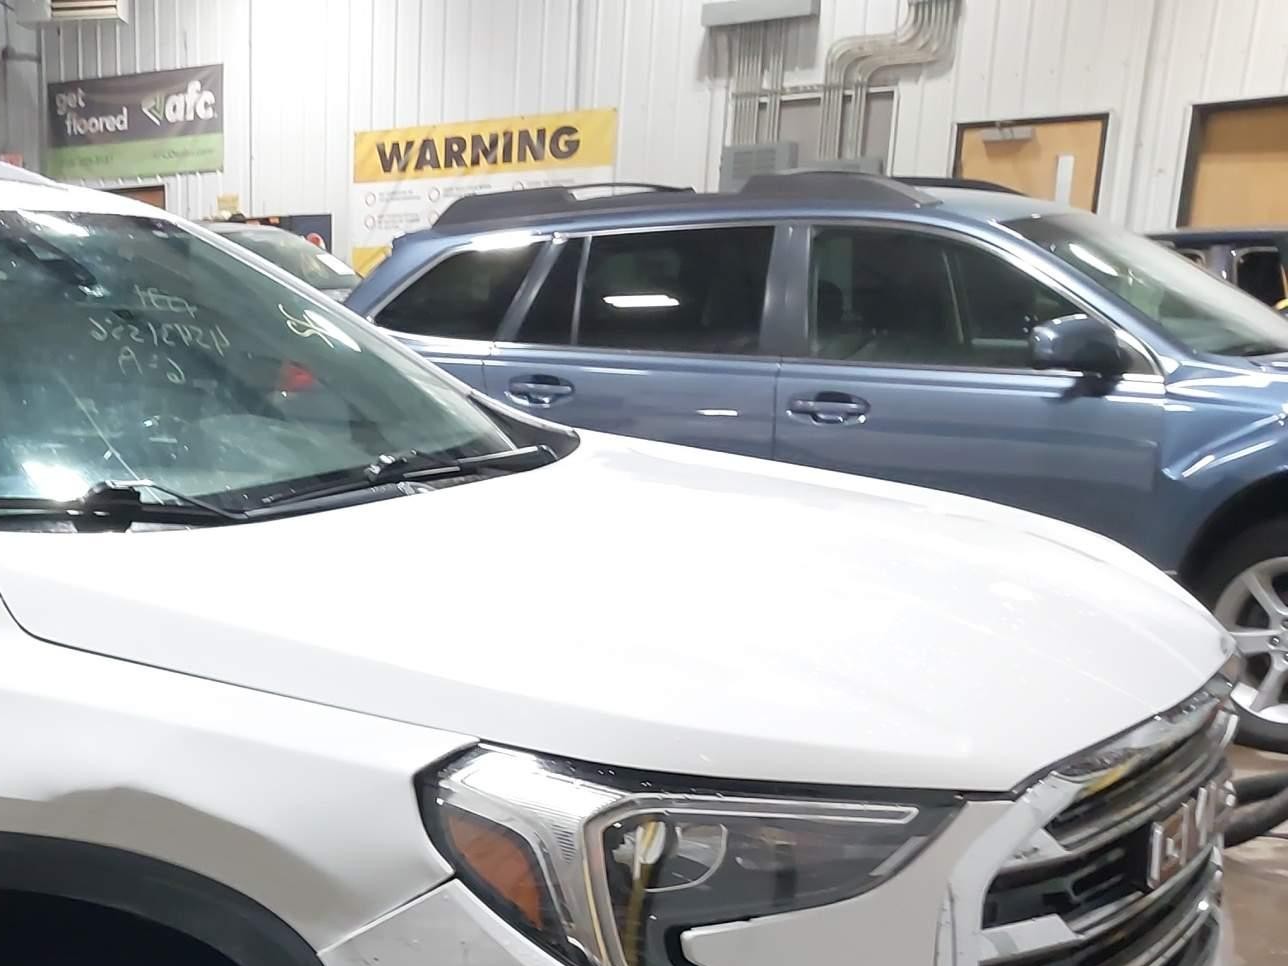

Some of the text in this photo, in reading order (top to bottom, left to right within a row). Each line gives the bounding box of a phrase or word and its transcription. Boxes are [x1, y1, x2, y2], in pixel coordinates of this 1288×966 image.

[55, 87, 86, 116] get
[65, 106, 128, 136] floored
[376, 125, 581, 173] WARNING
